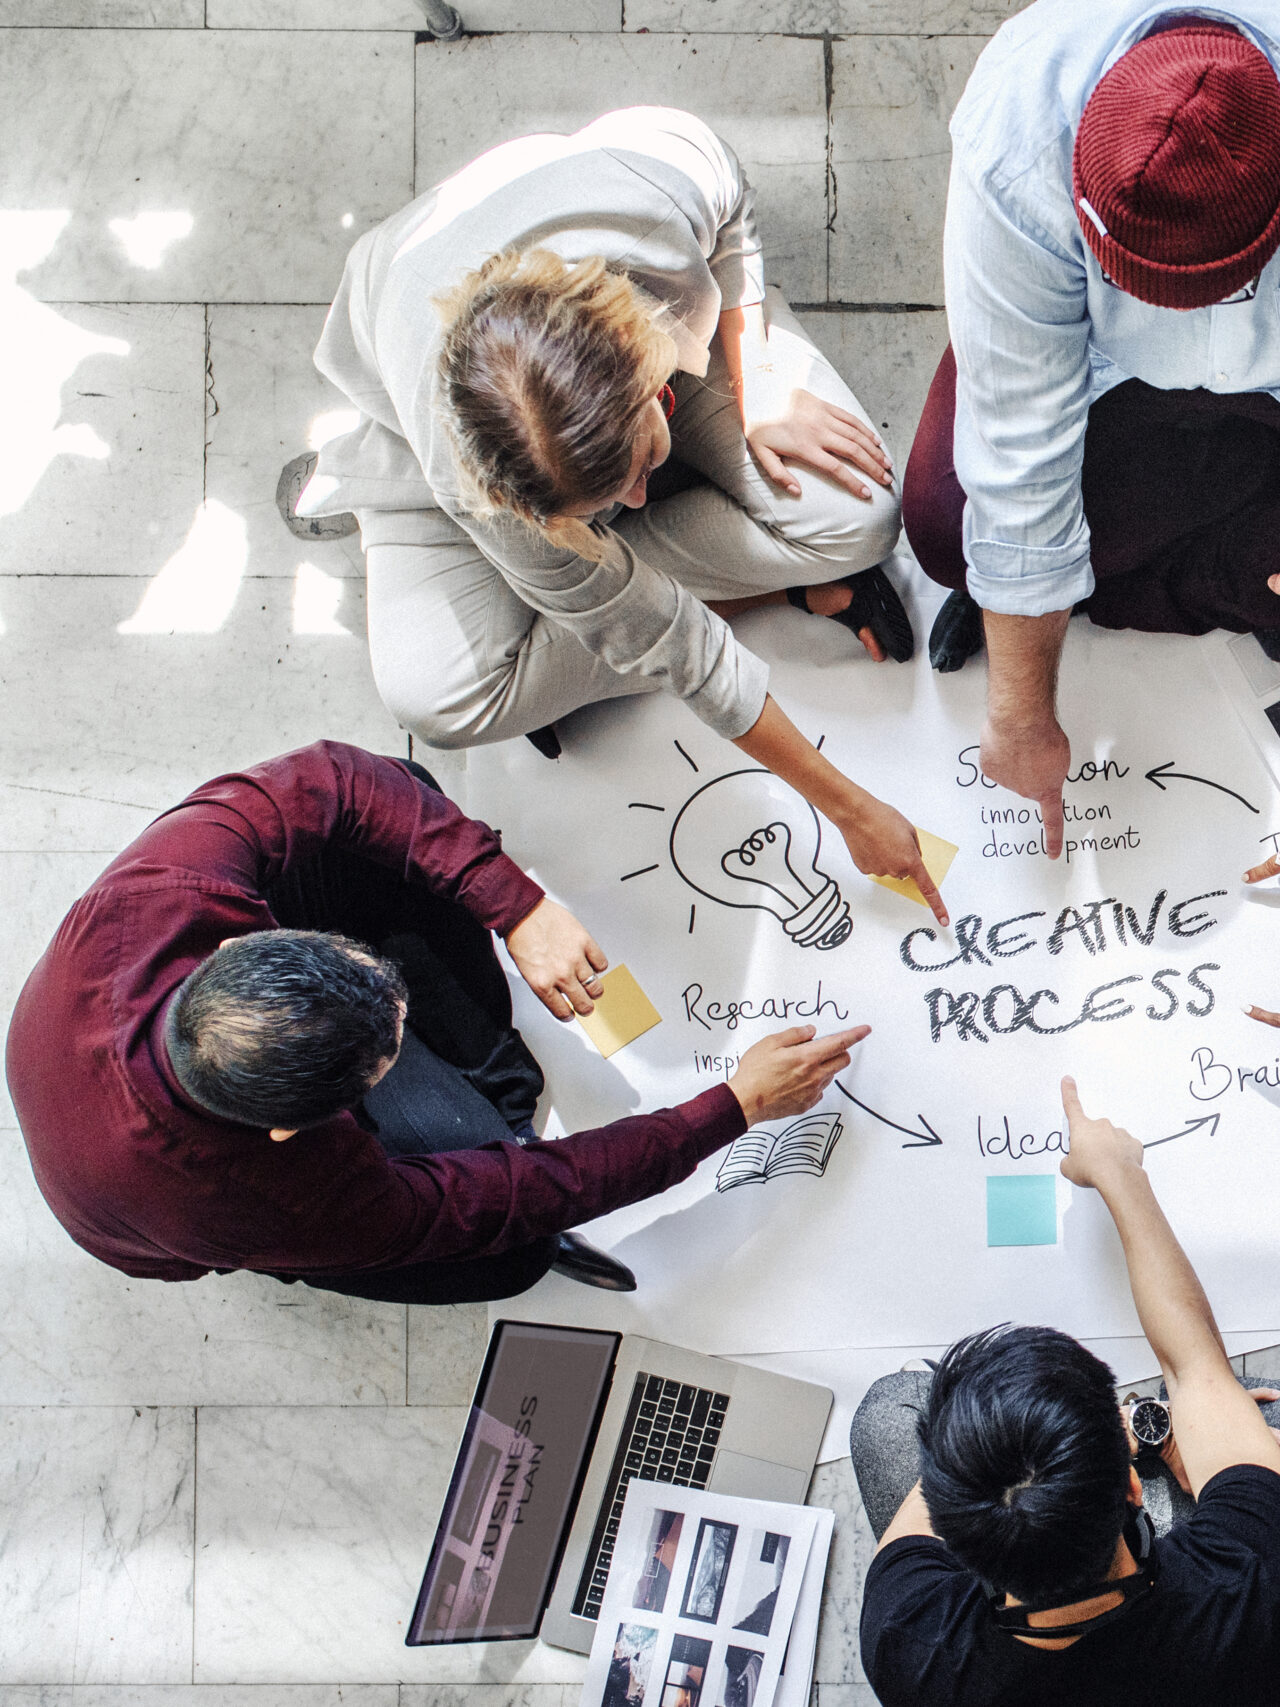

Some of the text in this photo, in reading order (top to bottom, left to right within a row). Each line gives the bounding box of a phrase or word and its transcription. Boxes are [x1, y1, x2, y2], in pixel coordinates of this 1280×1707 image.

[981, 799, 1112, 824] innovtion
[982, 825, 1141, 863] develpment
[899, 889, 1228, 972] CREATIVE
[681, 980, 849, 1031] Research
[924, 962, 1221, 1043] PROCESS
[978, 1115, 1070, 1159] Idea
[476, 1396, 538, 1571] BUSINESS
[512, 1444, 545, 1524] PLAN
